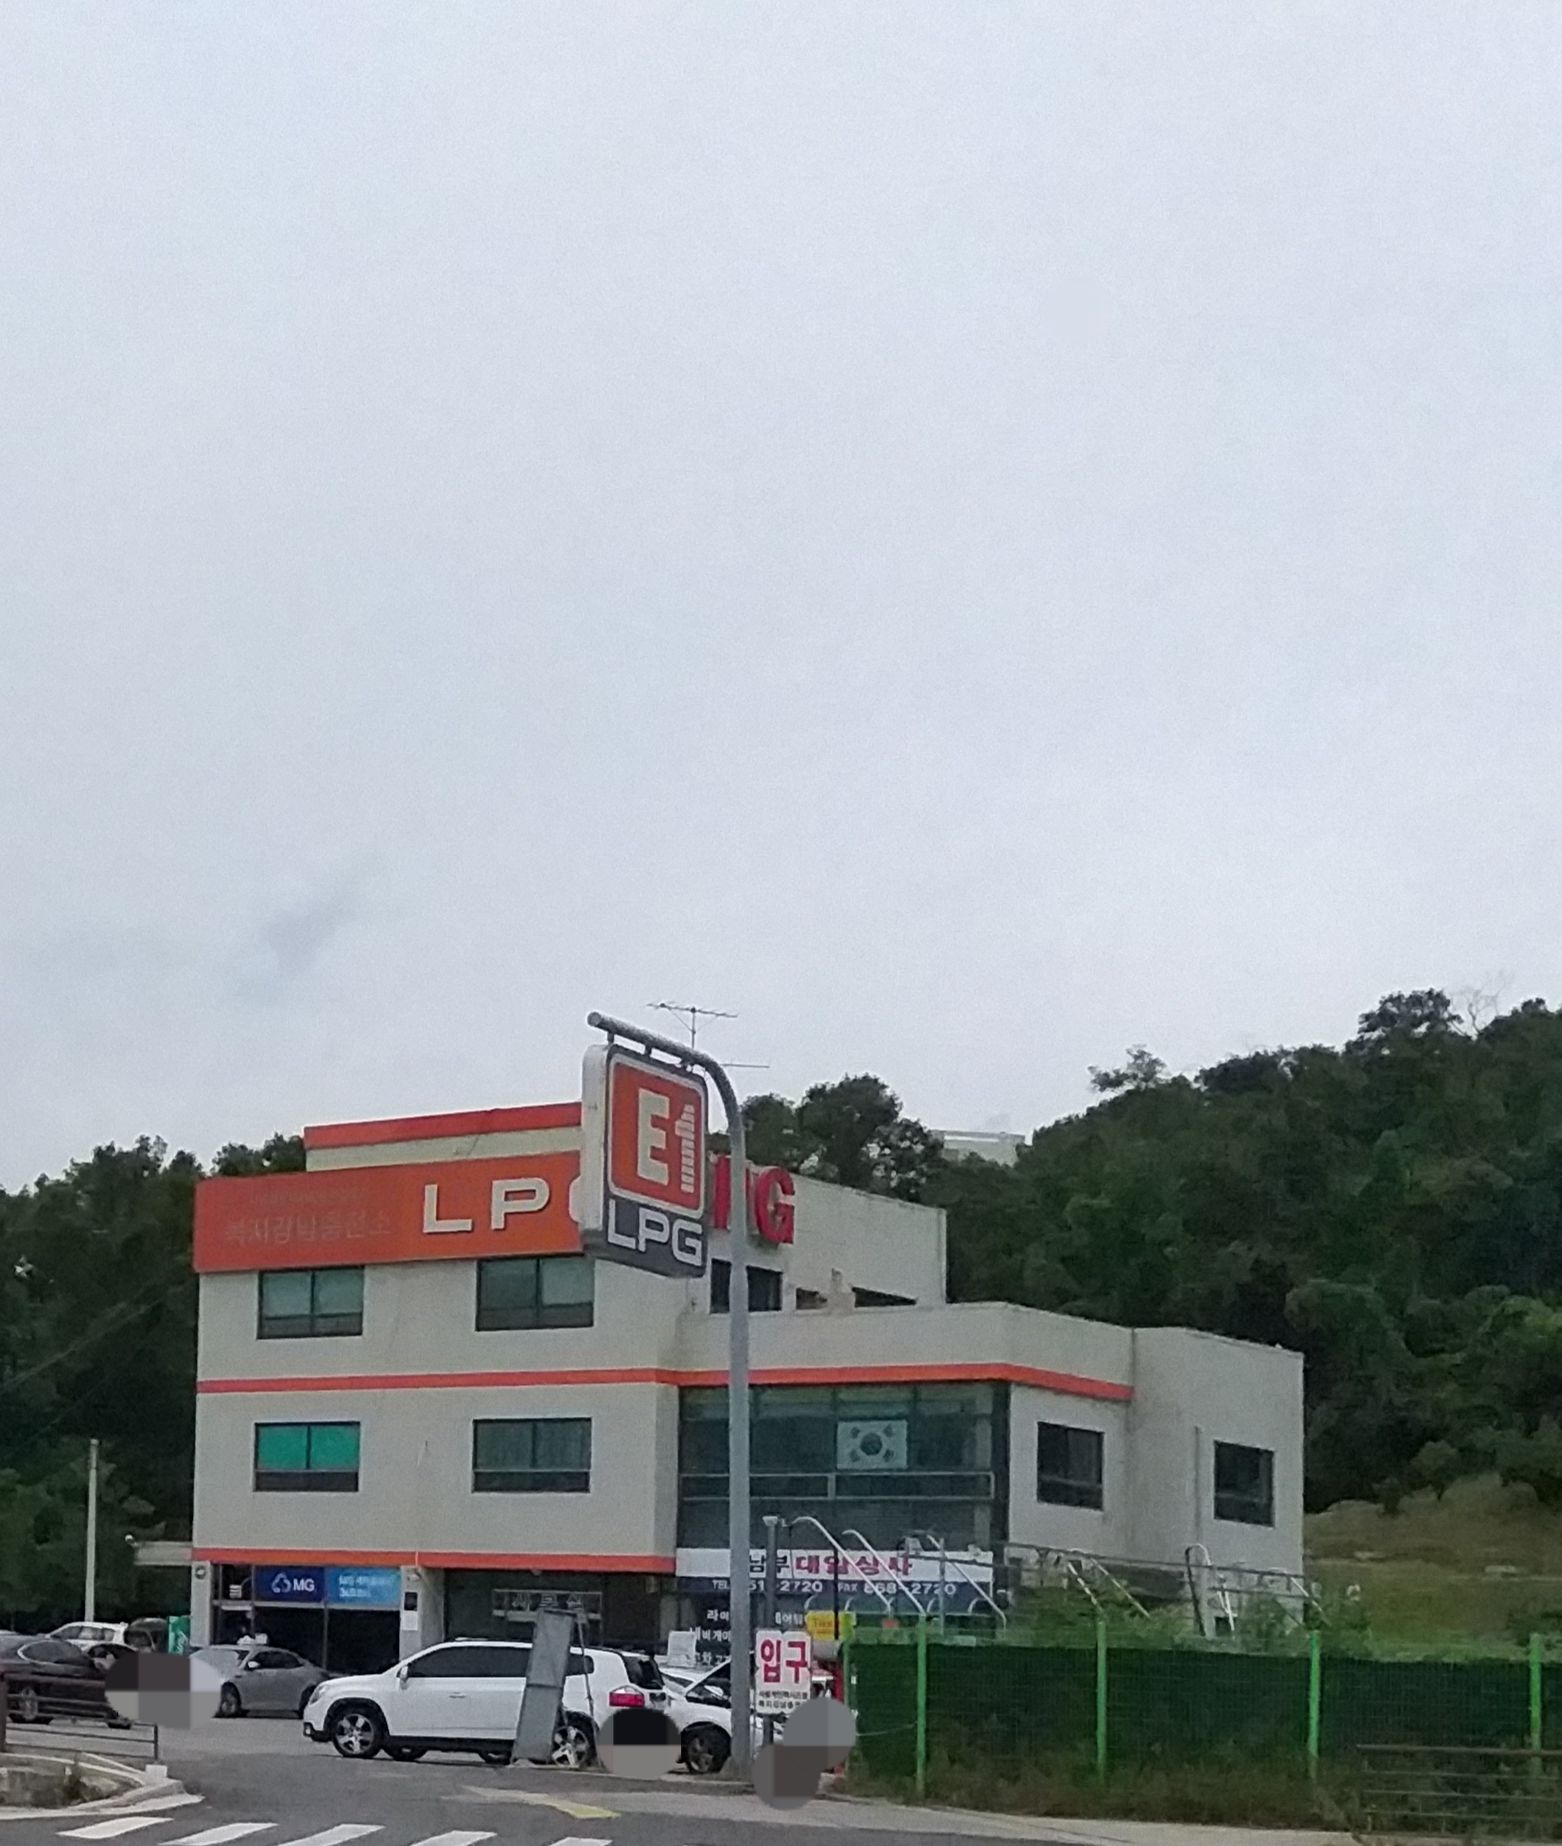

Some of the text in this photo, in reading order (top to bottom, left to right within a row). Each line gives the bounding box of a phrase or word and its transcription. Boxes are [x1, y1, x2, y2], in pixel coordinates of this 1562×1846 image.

[637, 1087, 696, 1194] E1
[422, 1176, 581, 1234] LP
[607, 1198, 703, 1267] LPG
[292, 1578, 315, 1592] MG
[760, 1639, 808, 1684] 입구
